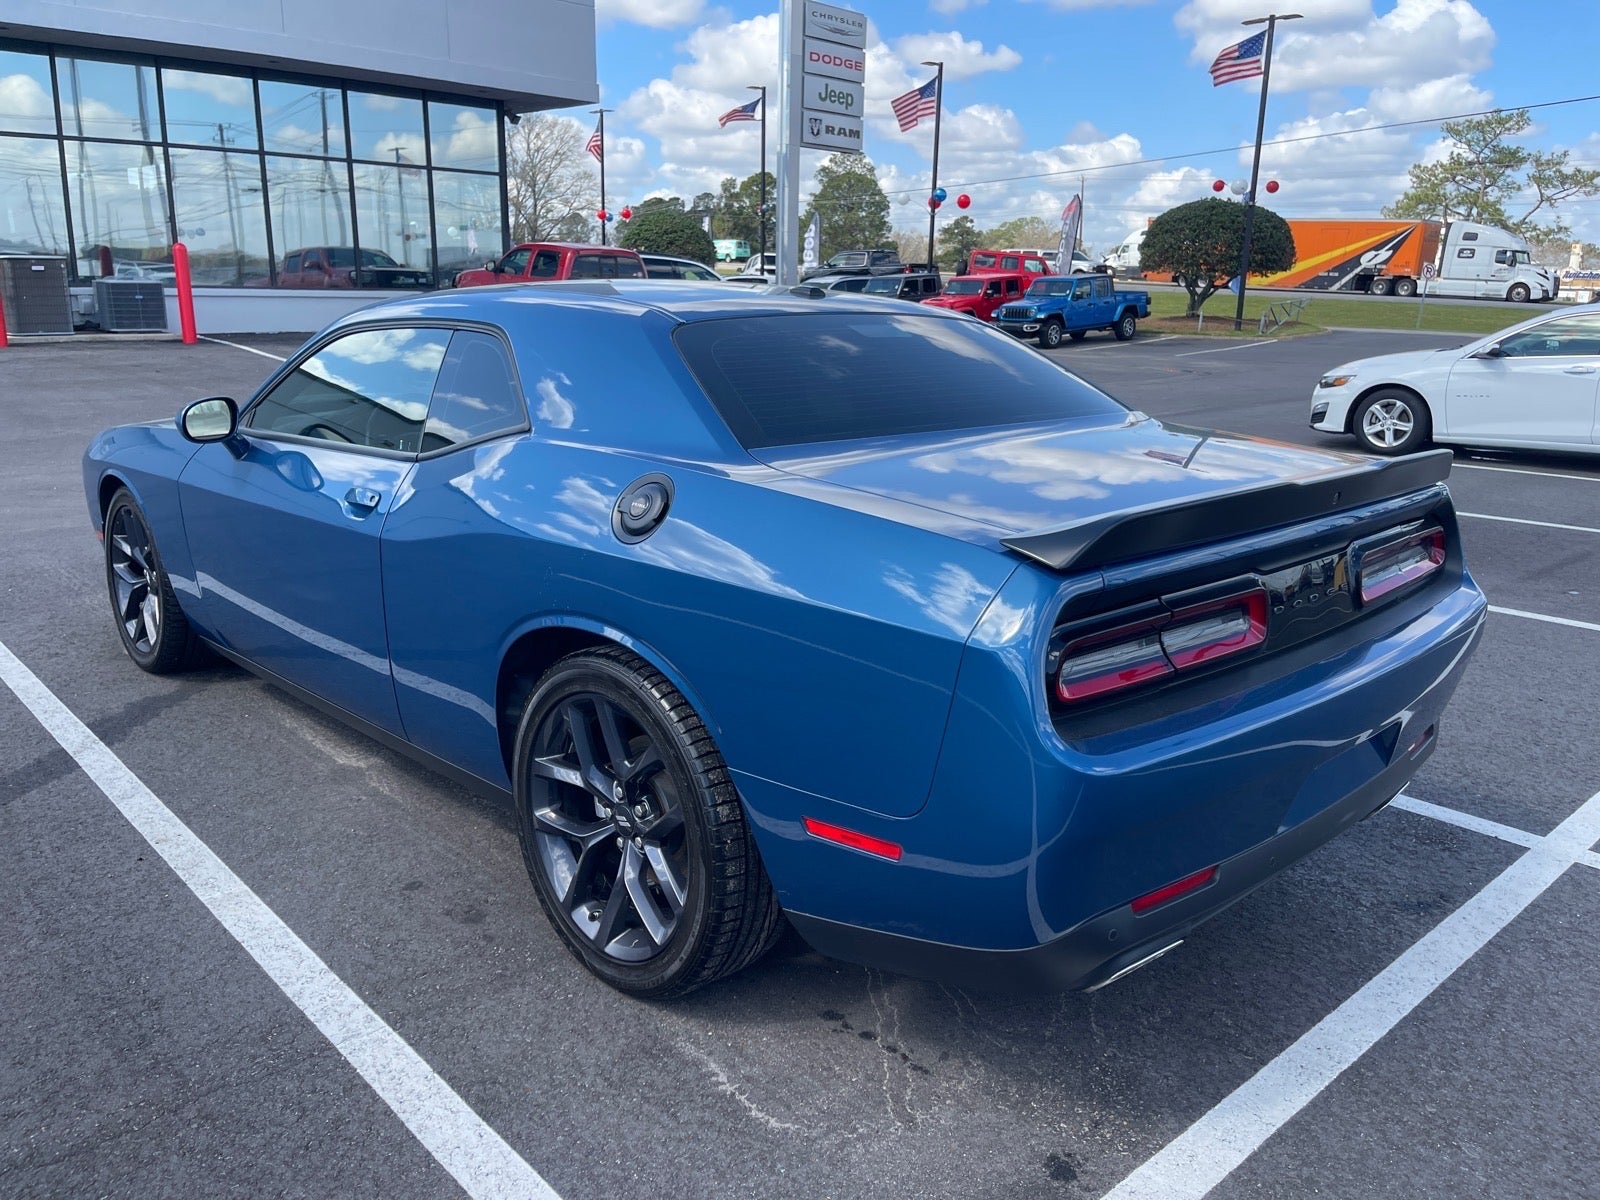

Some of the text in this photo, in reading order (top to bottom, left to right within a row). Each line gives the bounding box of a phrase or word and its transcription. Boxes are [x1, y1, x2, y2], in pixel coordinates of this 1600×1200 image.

[811, 10, 863, 29] CHRYSLER
[809, 51, 863, 72] DODGE
[818, 83, 854, 110] Jeep
[825, 125, 861, 140] RAM
